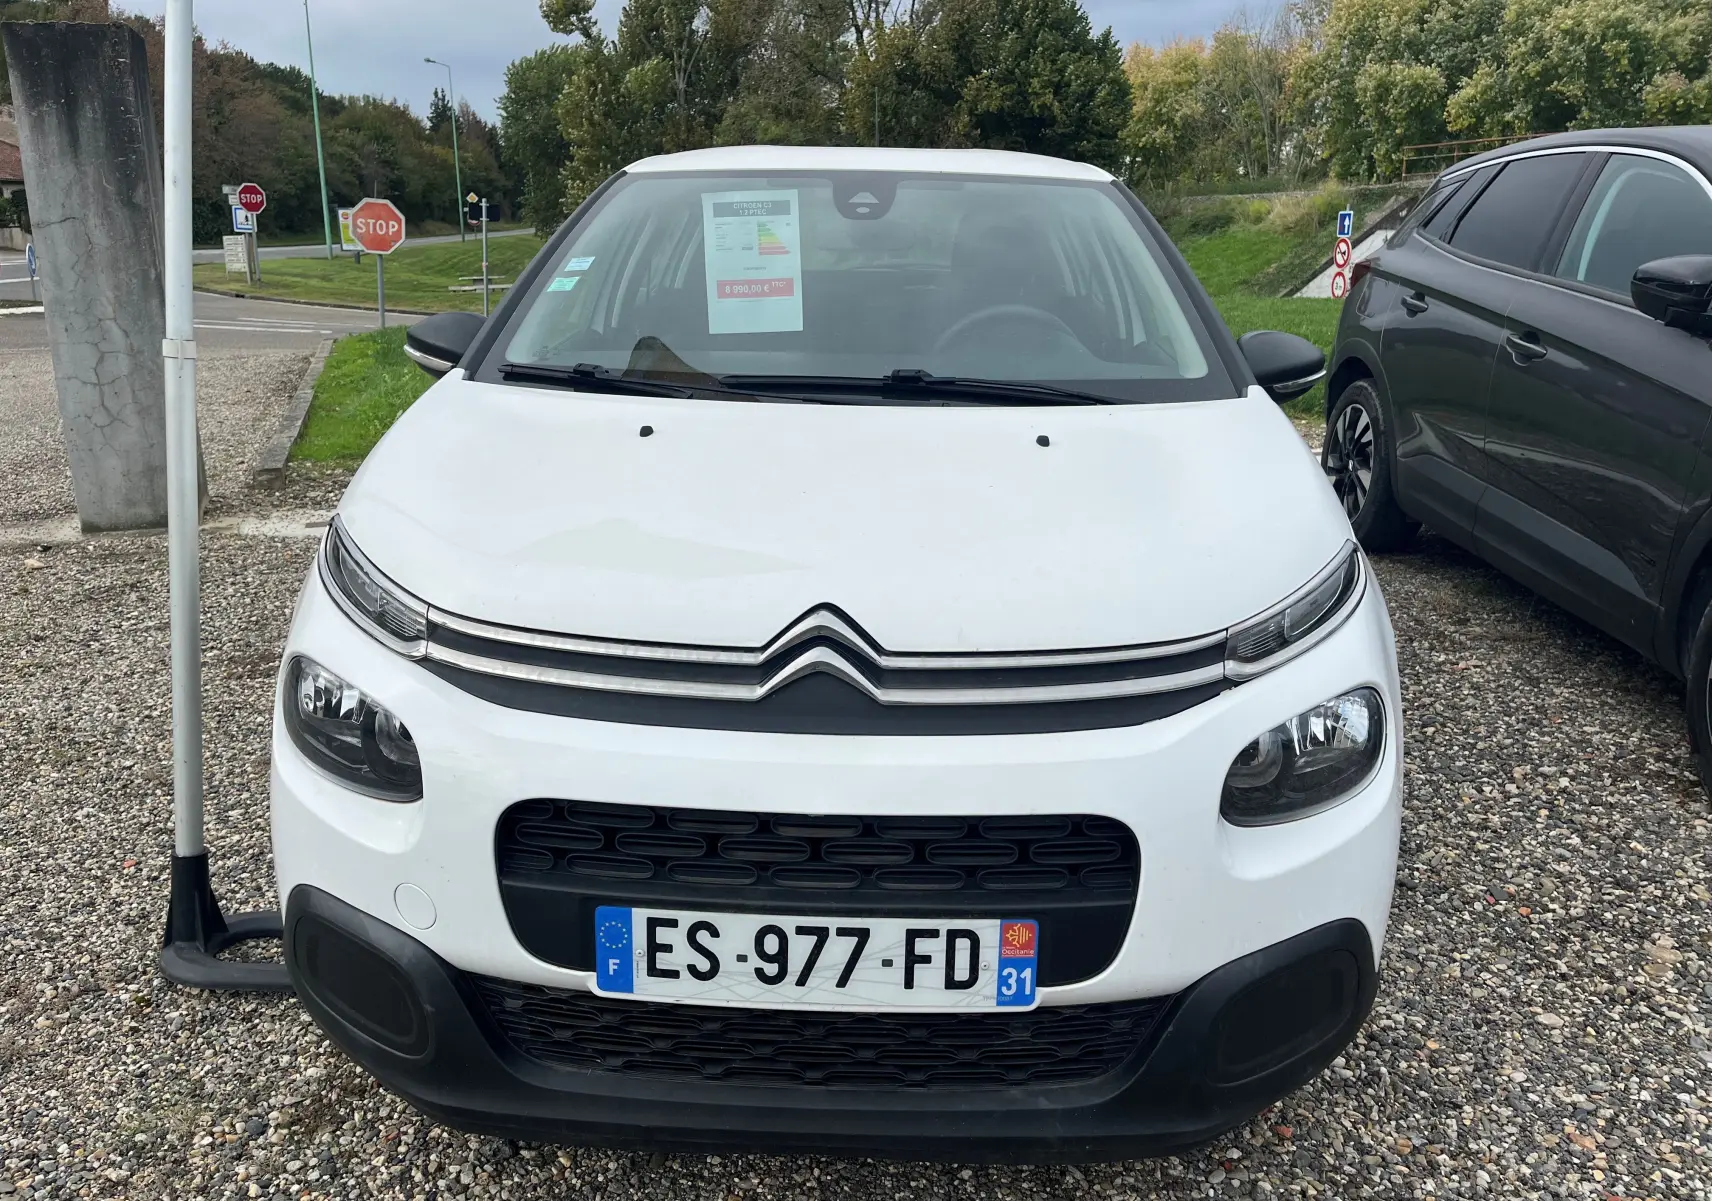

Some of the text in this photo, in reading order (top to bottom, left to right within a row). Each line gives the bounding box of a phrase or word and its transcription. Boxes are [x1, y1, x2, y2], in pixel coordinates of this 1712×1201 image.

[240, 194, 263, 203] STOP
[356, 218, 399, 236] STOP
[725, 285, 731, 294] 8
[732, 284, 762, 294] 990,00
[763, 284, 770, 293] €
[608, 958, 620, 976] F
[1001, 967, 1032, 996] 31
